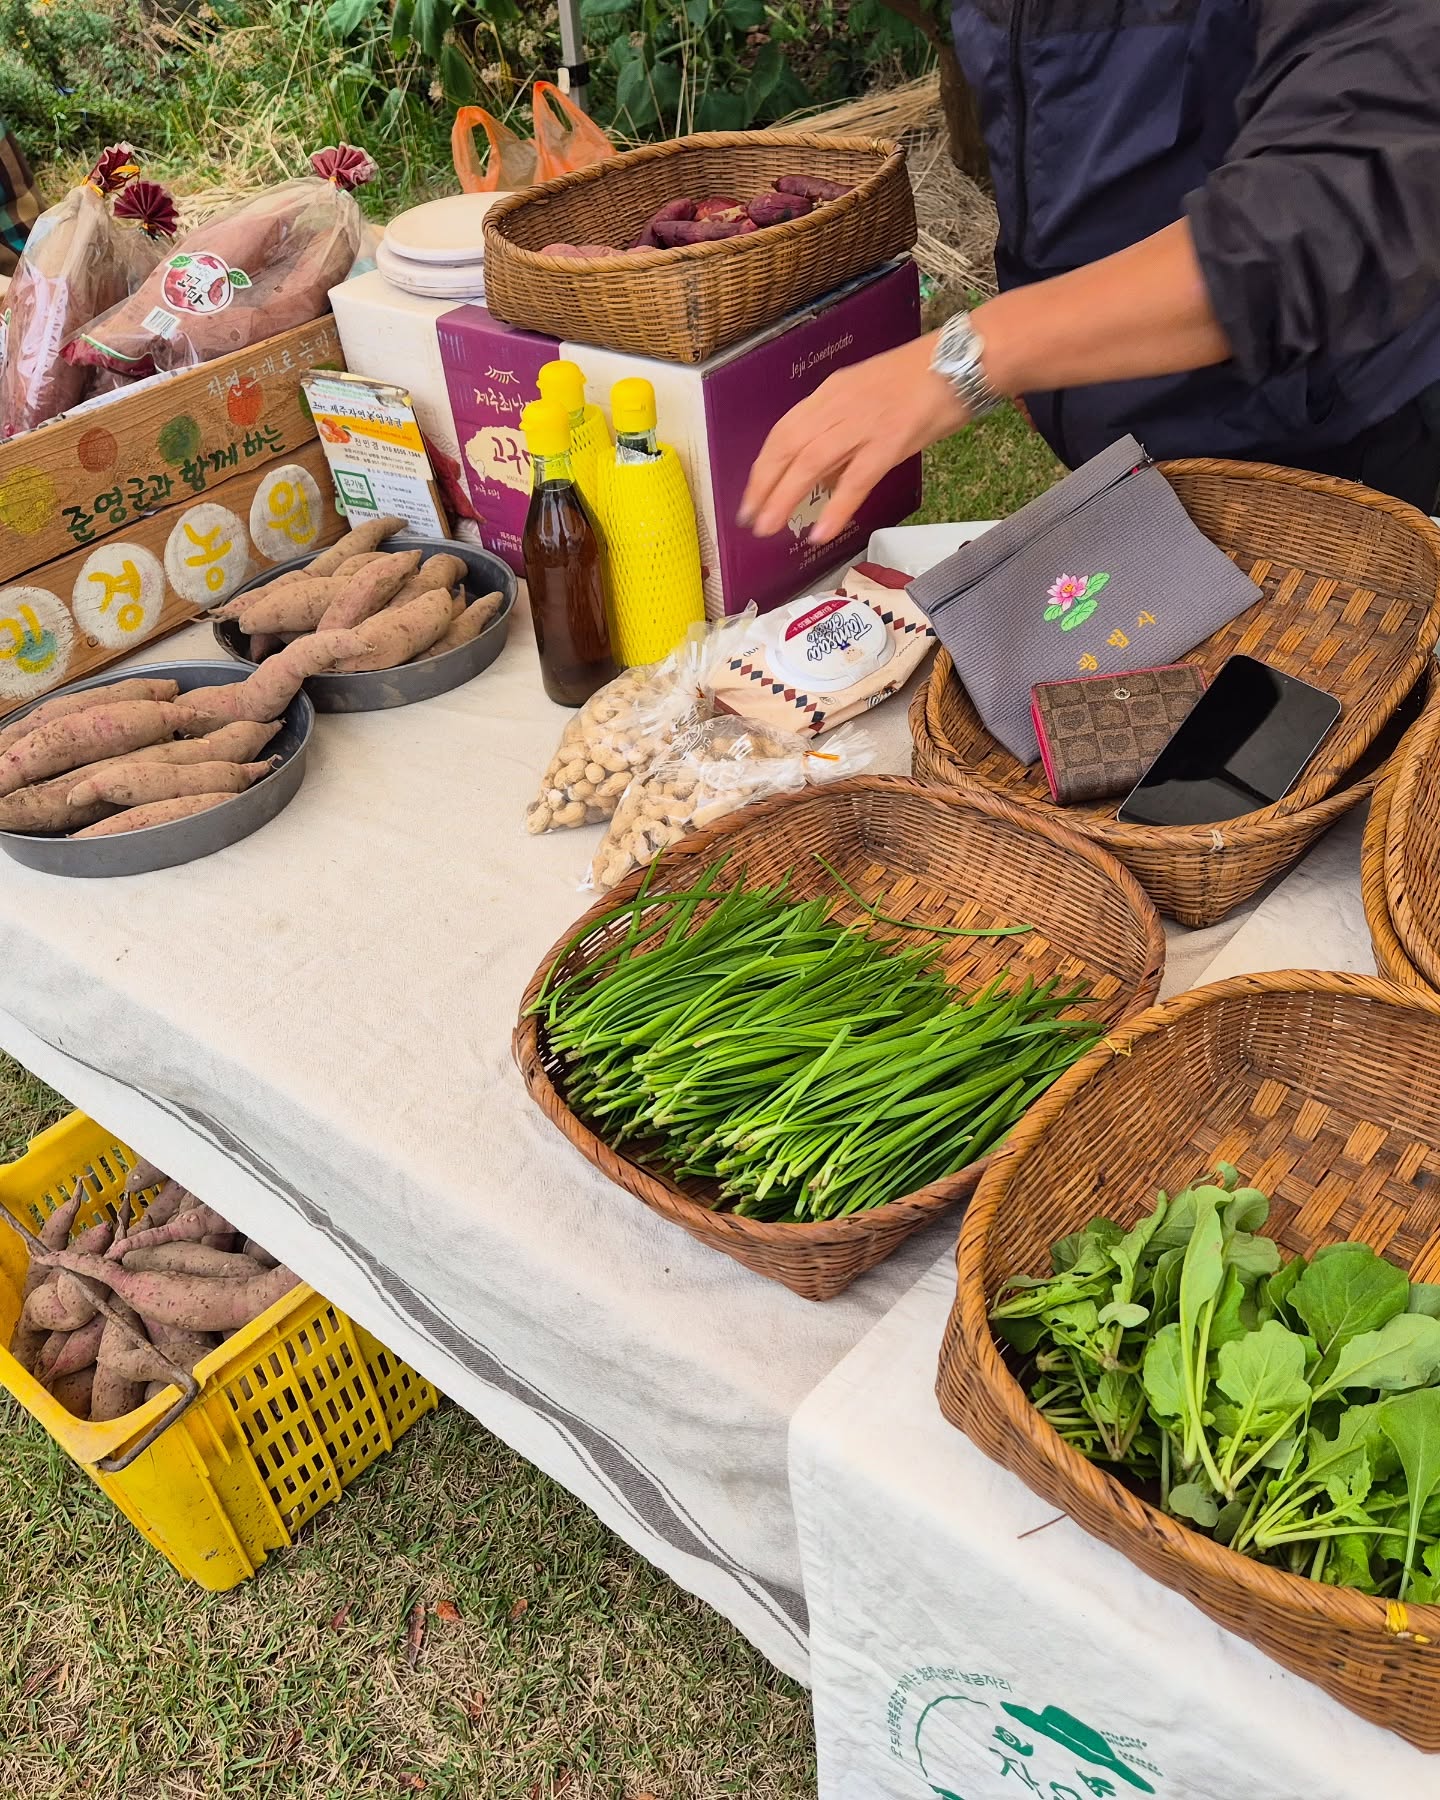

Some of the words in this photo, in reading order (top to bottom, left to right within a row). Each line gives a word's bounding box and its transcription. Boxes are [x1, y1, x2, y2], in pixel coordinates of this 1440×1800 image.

[789, 357, 807, 380] Jeju
[806, 333, 854, 370] Sweetpotato
[806, 612, 873, 662] Tamsaa
[959, 1671, 1013, 1693] 보금자리
